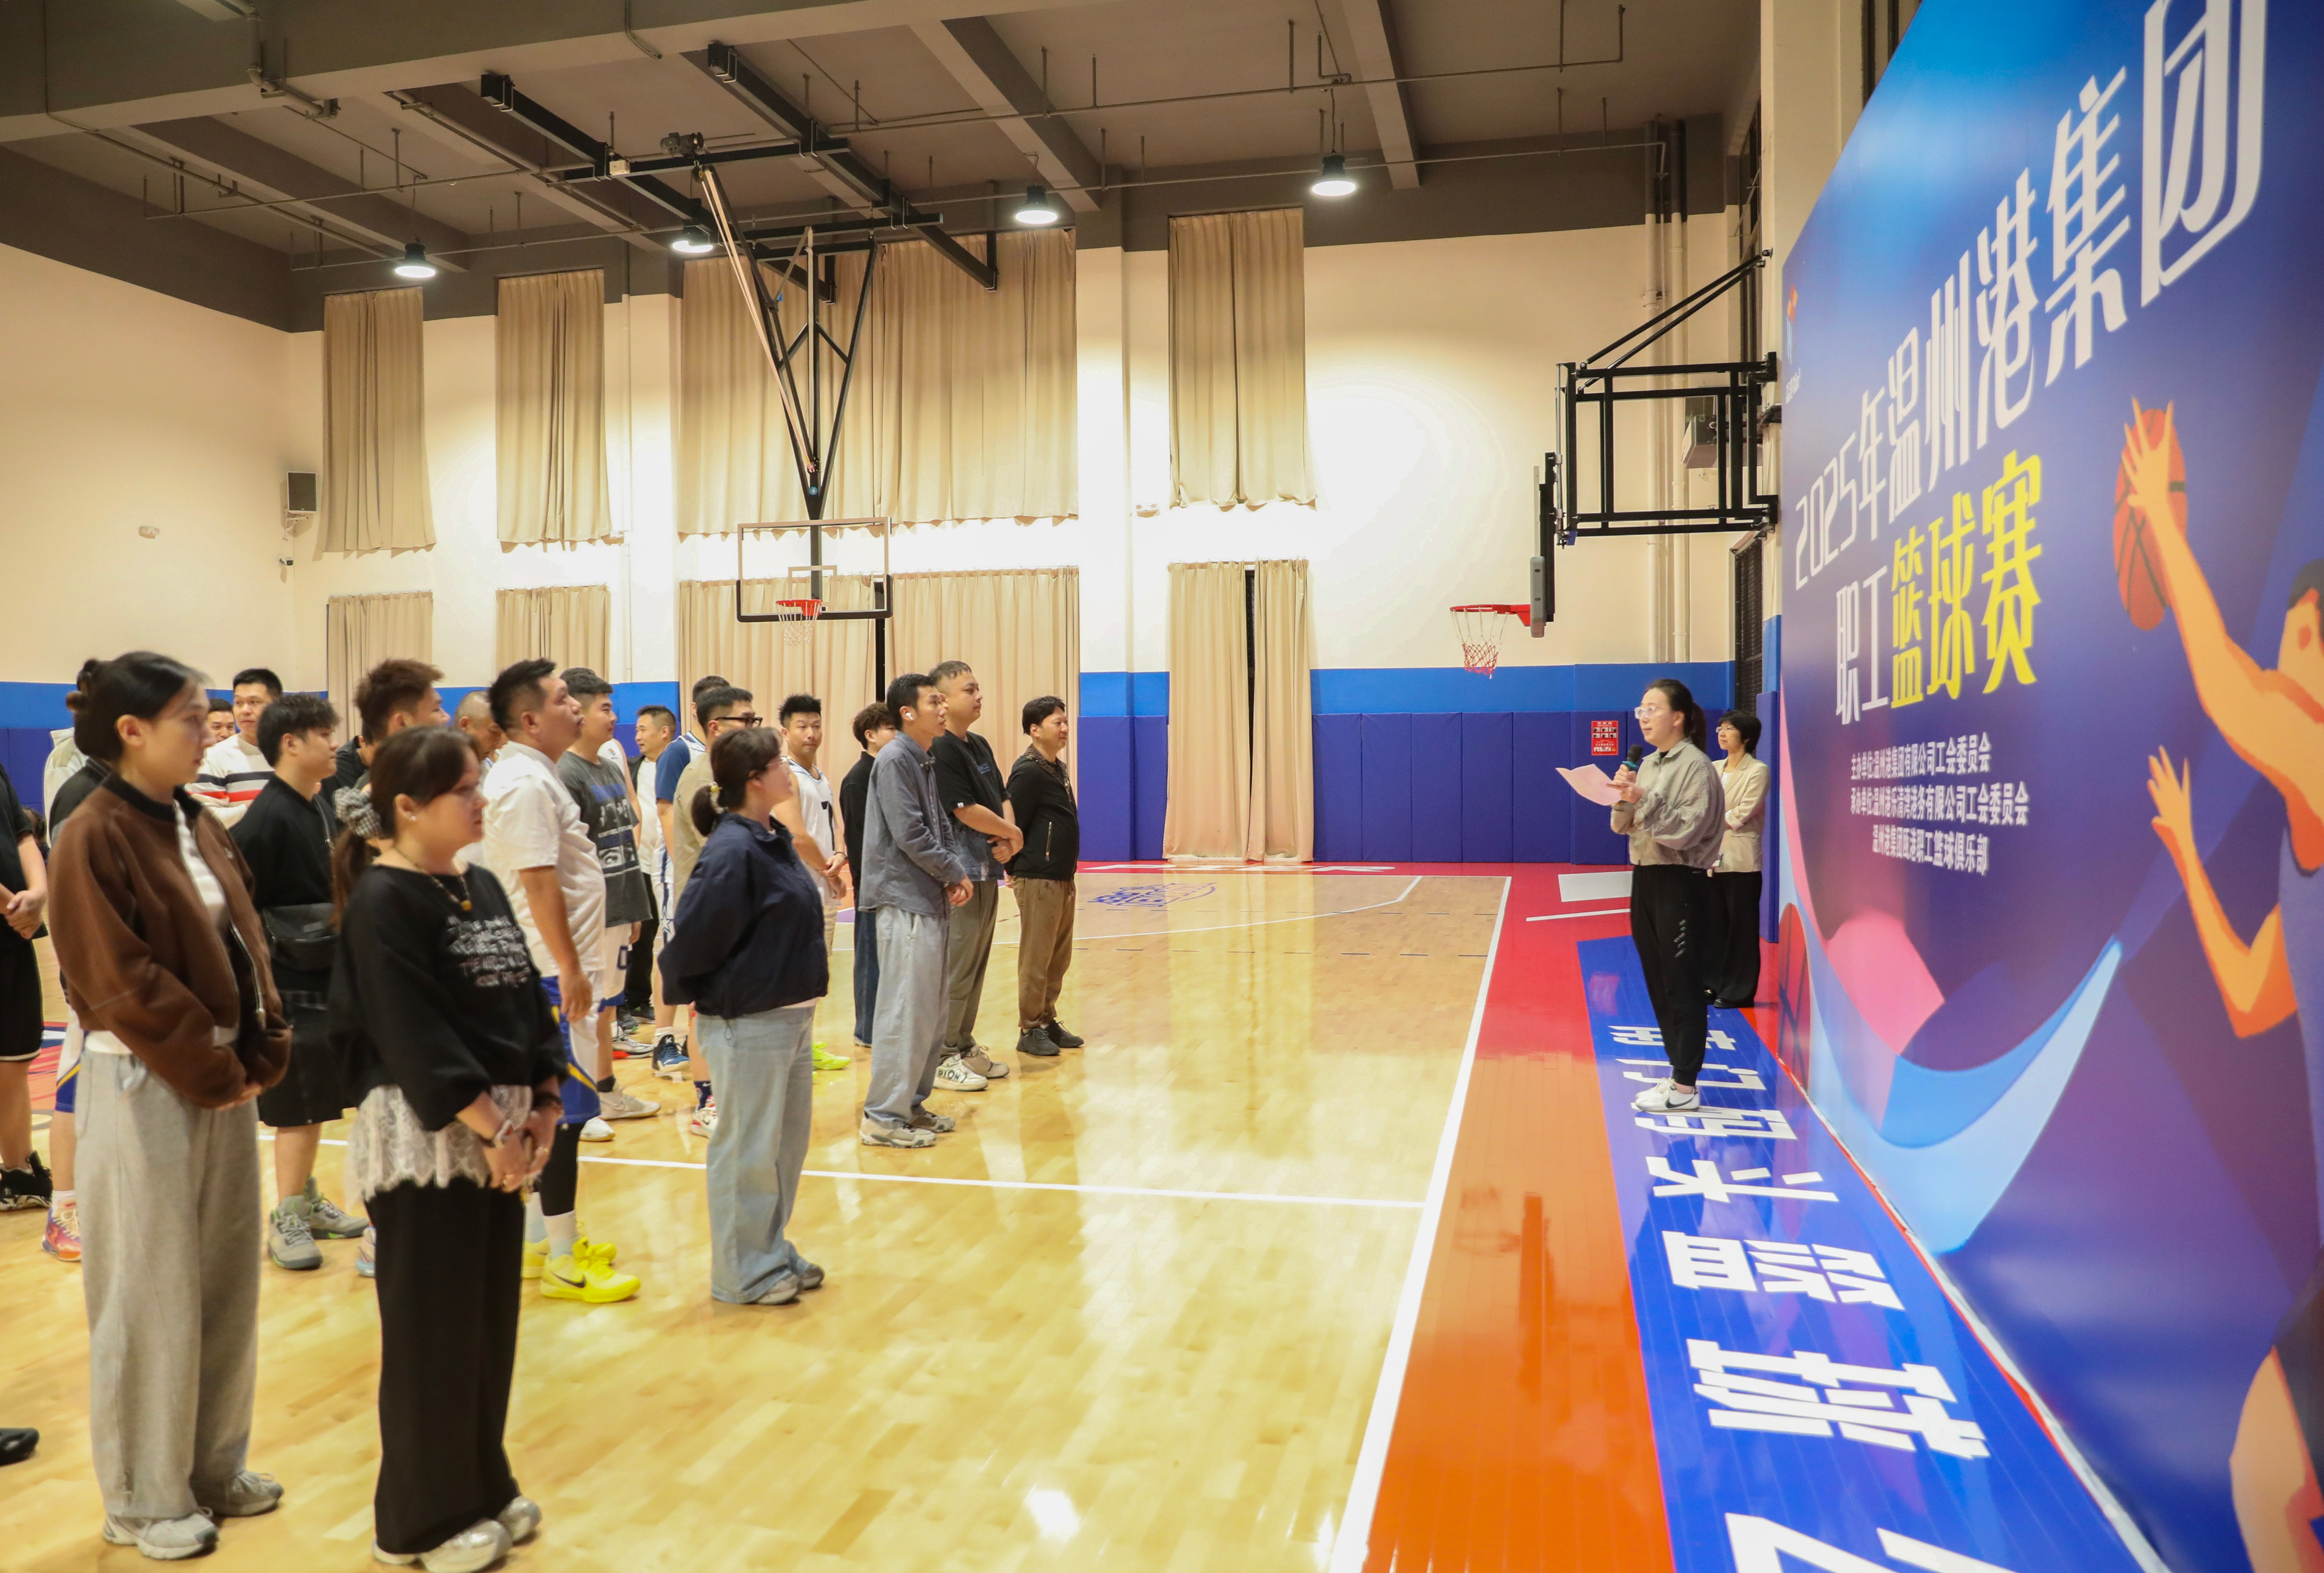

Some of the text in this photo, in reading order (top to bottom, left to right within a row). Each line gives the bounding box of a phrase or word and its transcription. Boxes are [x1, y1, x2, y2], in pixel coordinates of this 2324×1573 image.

[1796, 0, 2267, 591] 2025年温州港集团
[1836, 449, 2042, 725] 职工篮球赛
